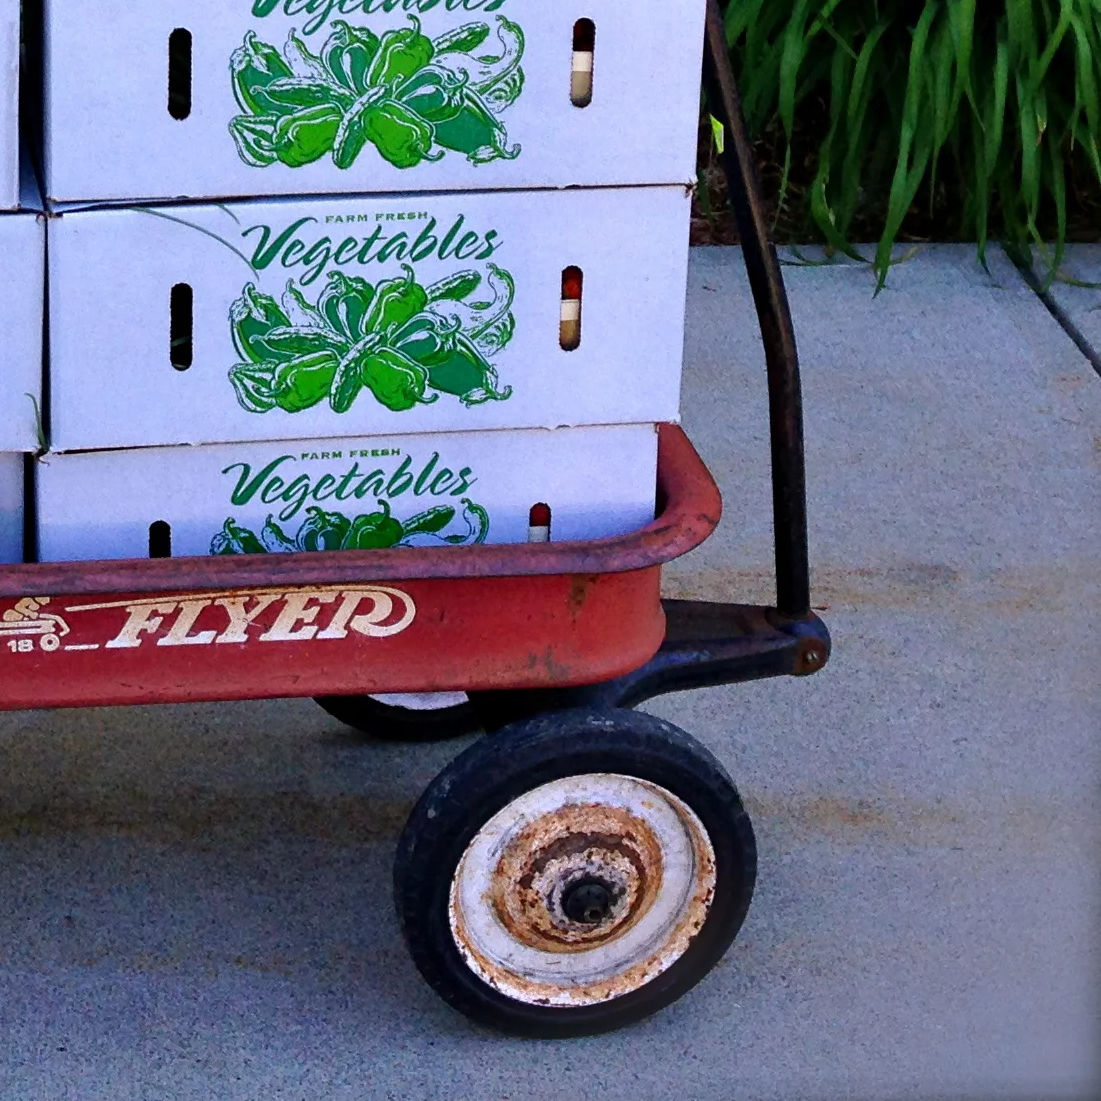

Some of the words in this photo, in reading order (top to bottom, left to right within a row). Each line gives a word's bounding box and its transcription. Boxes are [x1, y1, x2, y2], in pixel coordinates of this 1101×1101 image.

[241, 213, 504, 286] Vegetables
[325, 214, 368, 223] FARM
[375, 212, 428, 222] FRESH
[221, 451, 478, 522] Vegetables
[301, 451, 342, 460] FARM
[349, 449, 401, 458] FRESH
[7, 637, 34, 653] 18
[105, 585, 416, 649] FLYER
